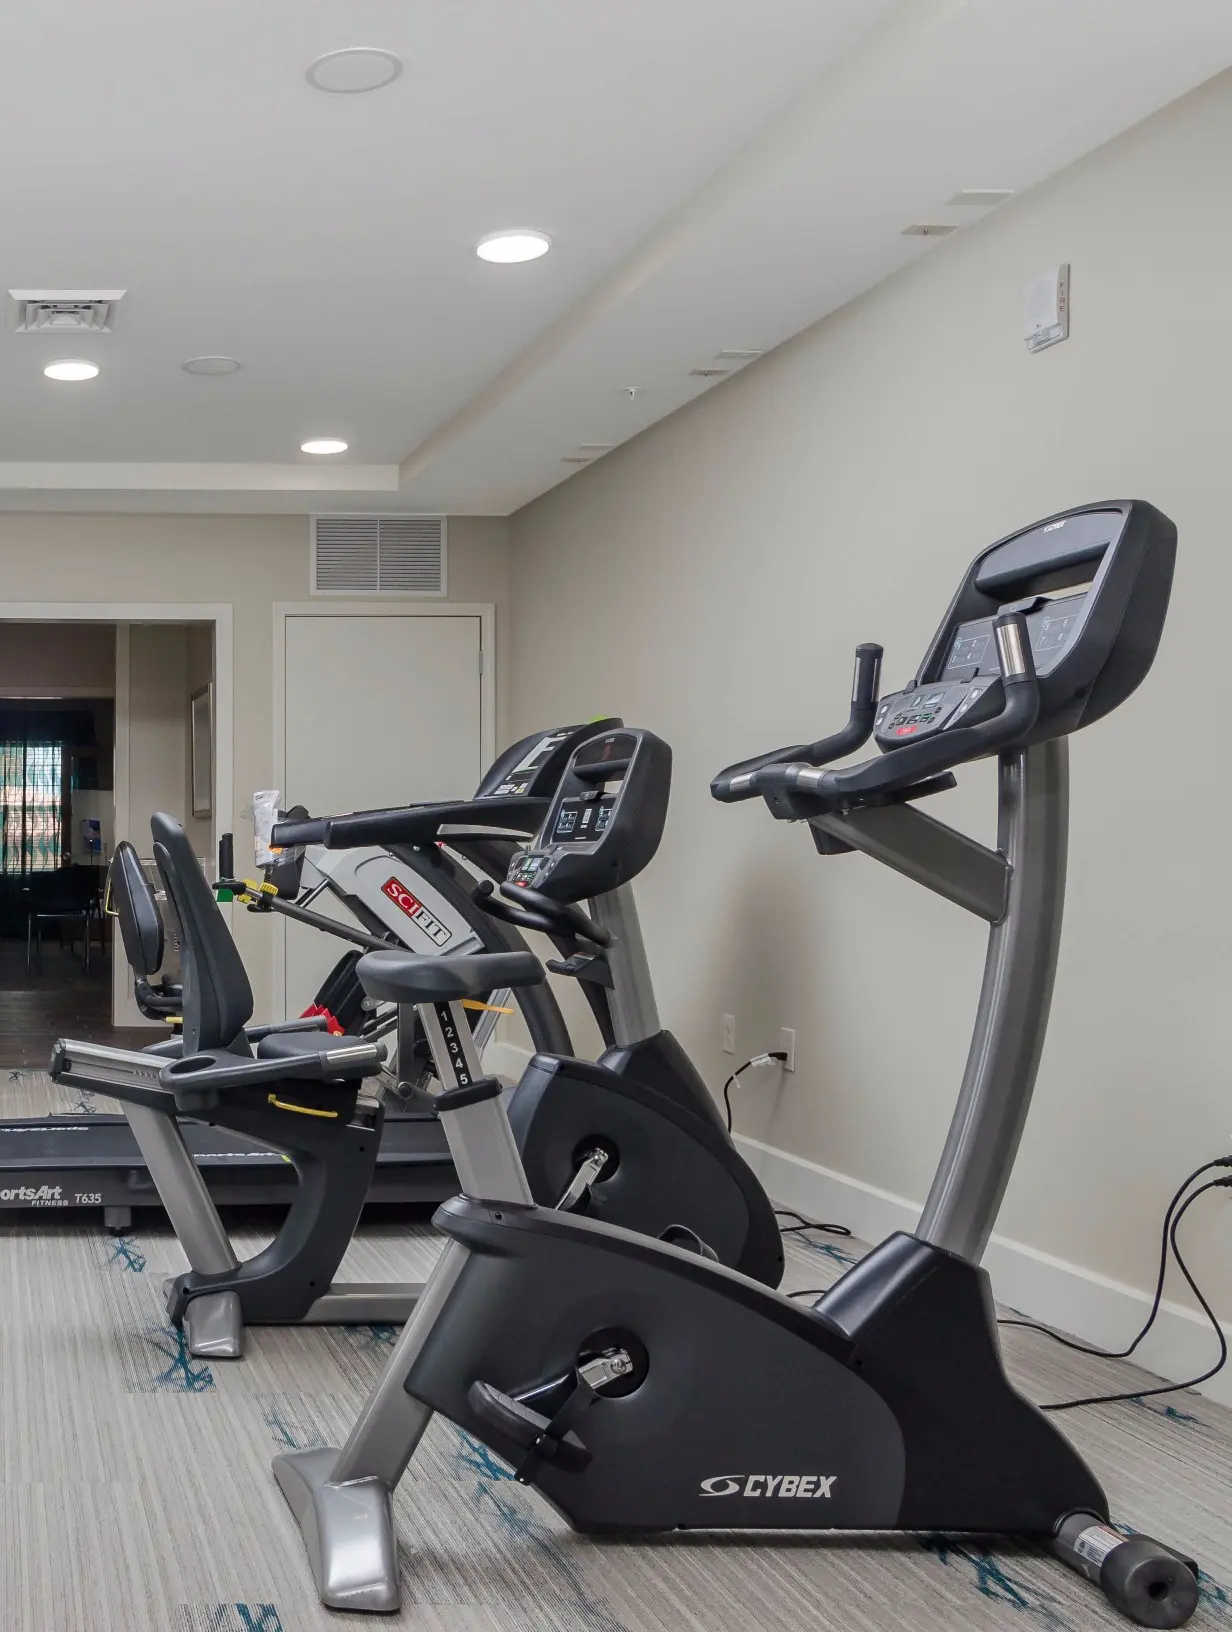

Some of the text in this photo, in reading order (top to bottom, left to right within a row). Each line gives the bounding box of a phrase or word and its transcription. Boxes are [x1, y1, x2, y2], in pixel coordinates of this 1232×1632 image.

[386, 883, 446, 937] SCIFIT
[441, 1011, 448, 1022] 1
[445, 1026, 455, 1038] 2
[449, 1042, 459, 1053] 3
[455, 1057, 464, 1068] 4
[459, 1073, 468, 1085] 5
[74, 1193, 102, 1204] T635
[743, 1474, 837, 1498] CYBEX
